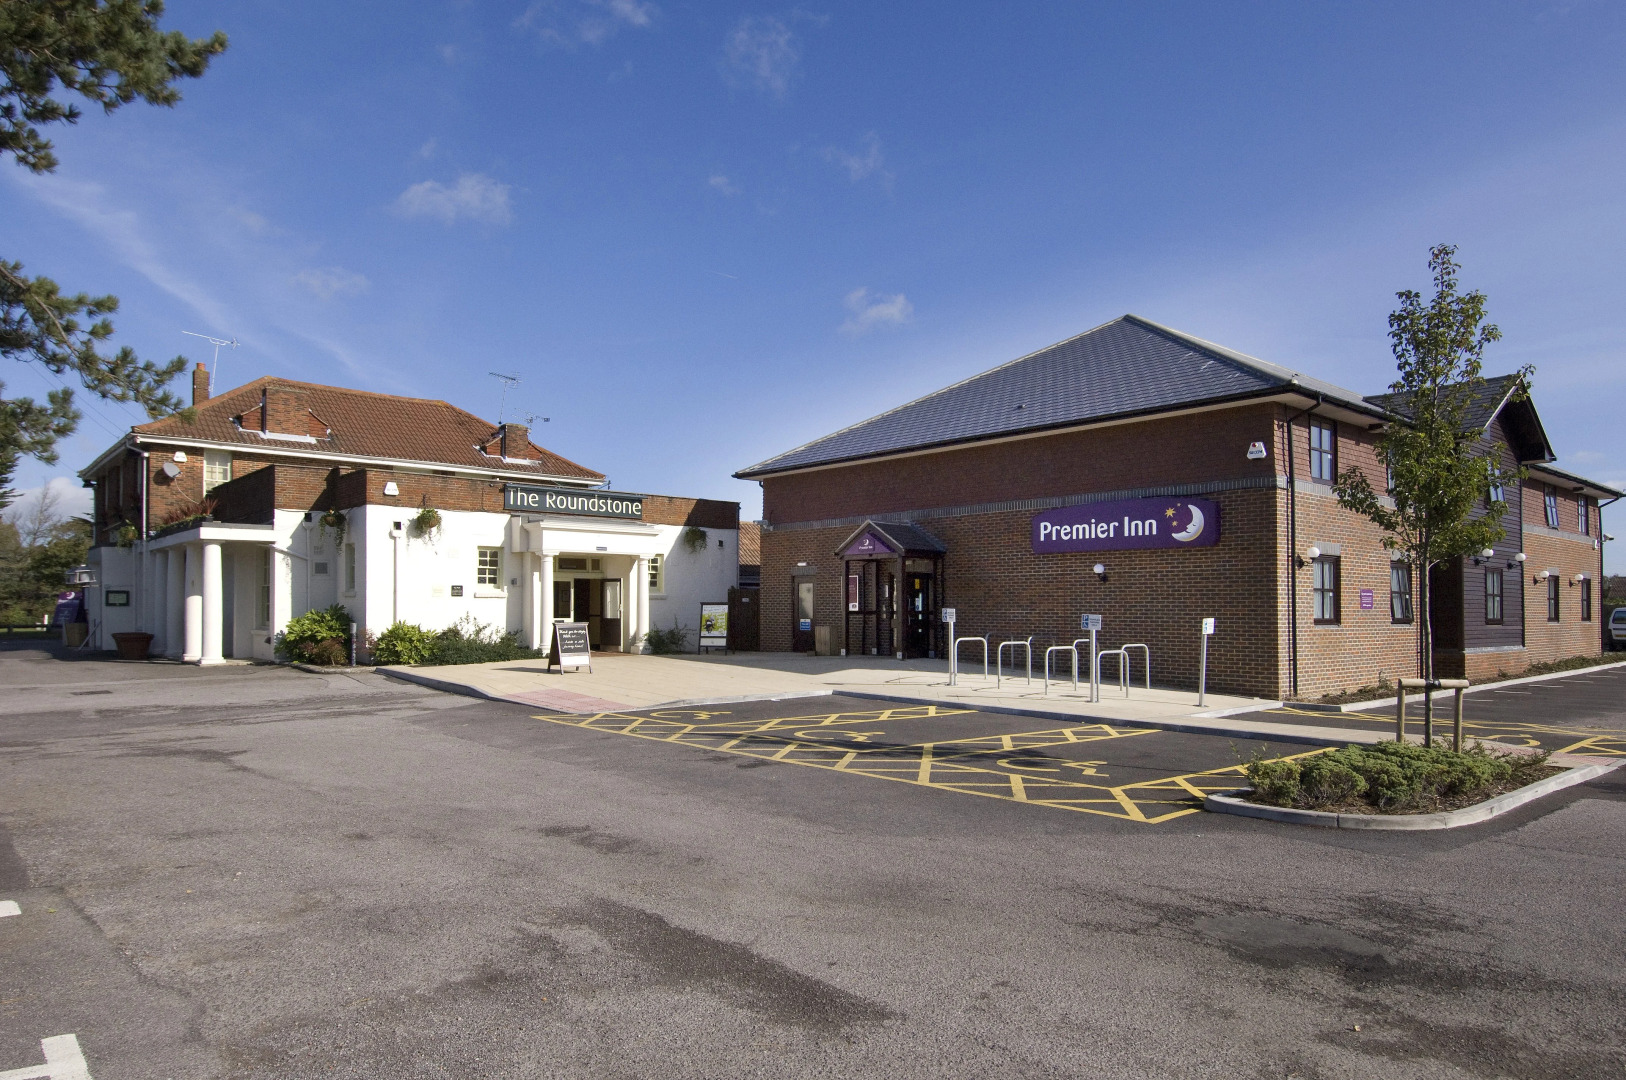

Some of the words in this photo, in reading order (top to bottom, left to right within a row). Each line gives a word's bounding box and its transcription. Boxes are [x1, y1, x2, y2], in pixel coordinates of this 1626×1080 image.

[509, 487, 539, 507] The
[546, 492, 642, 515] Roundstone
[1040, 519, 1119, 541] Premier
[1124, 516, 1157, 537] Inn
